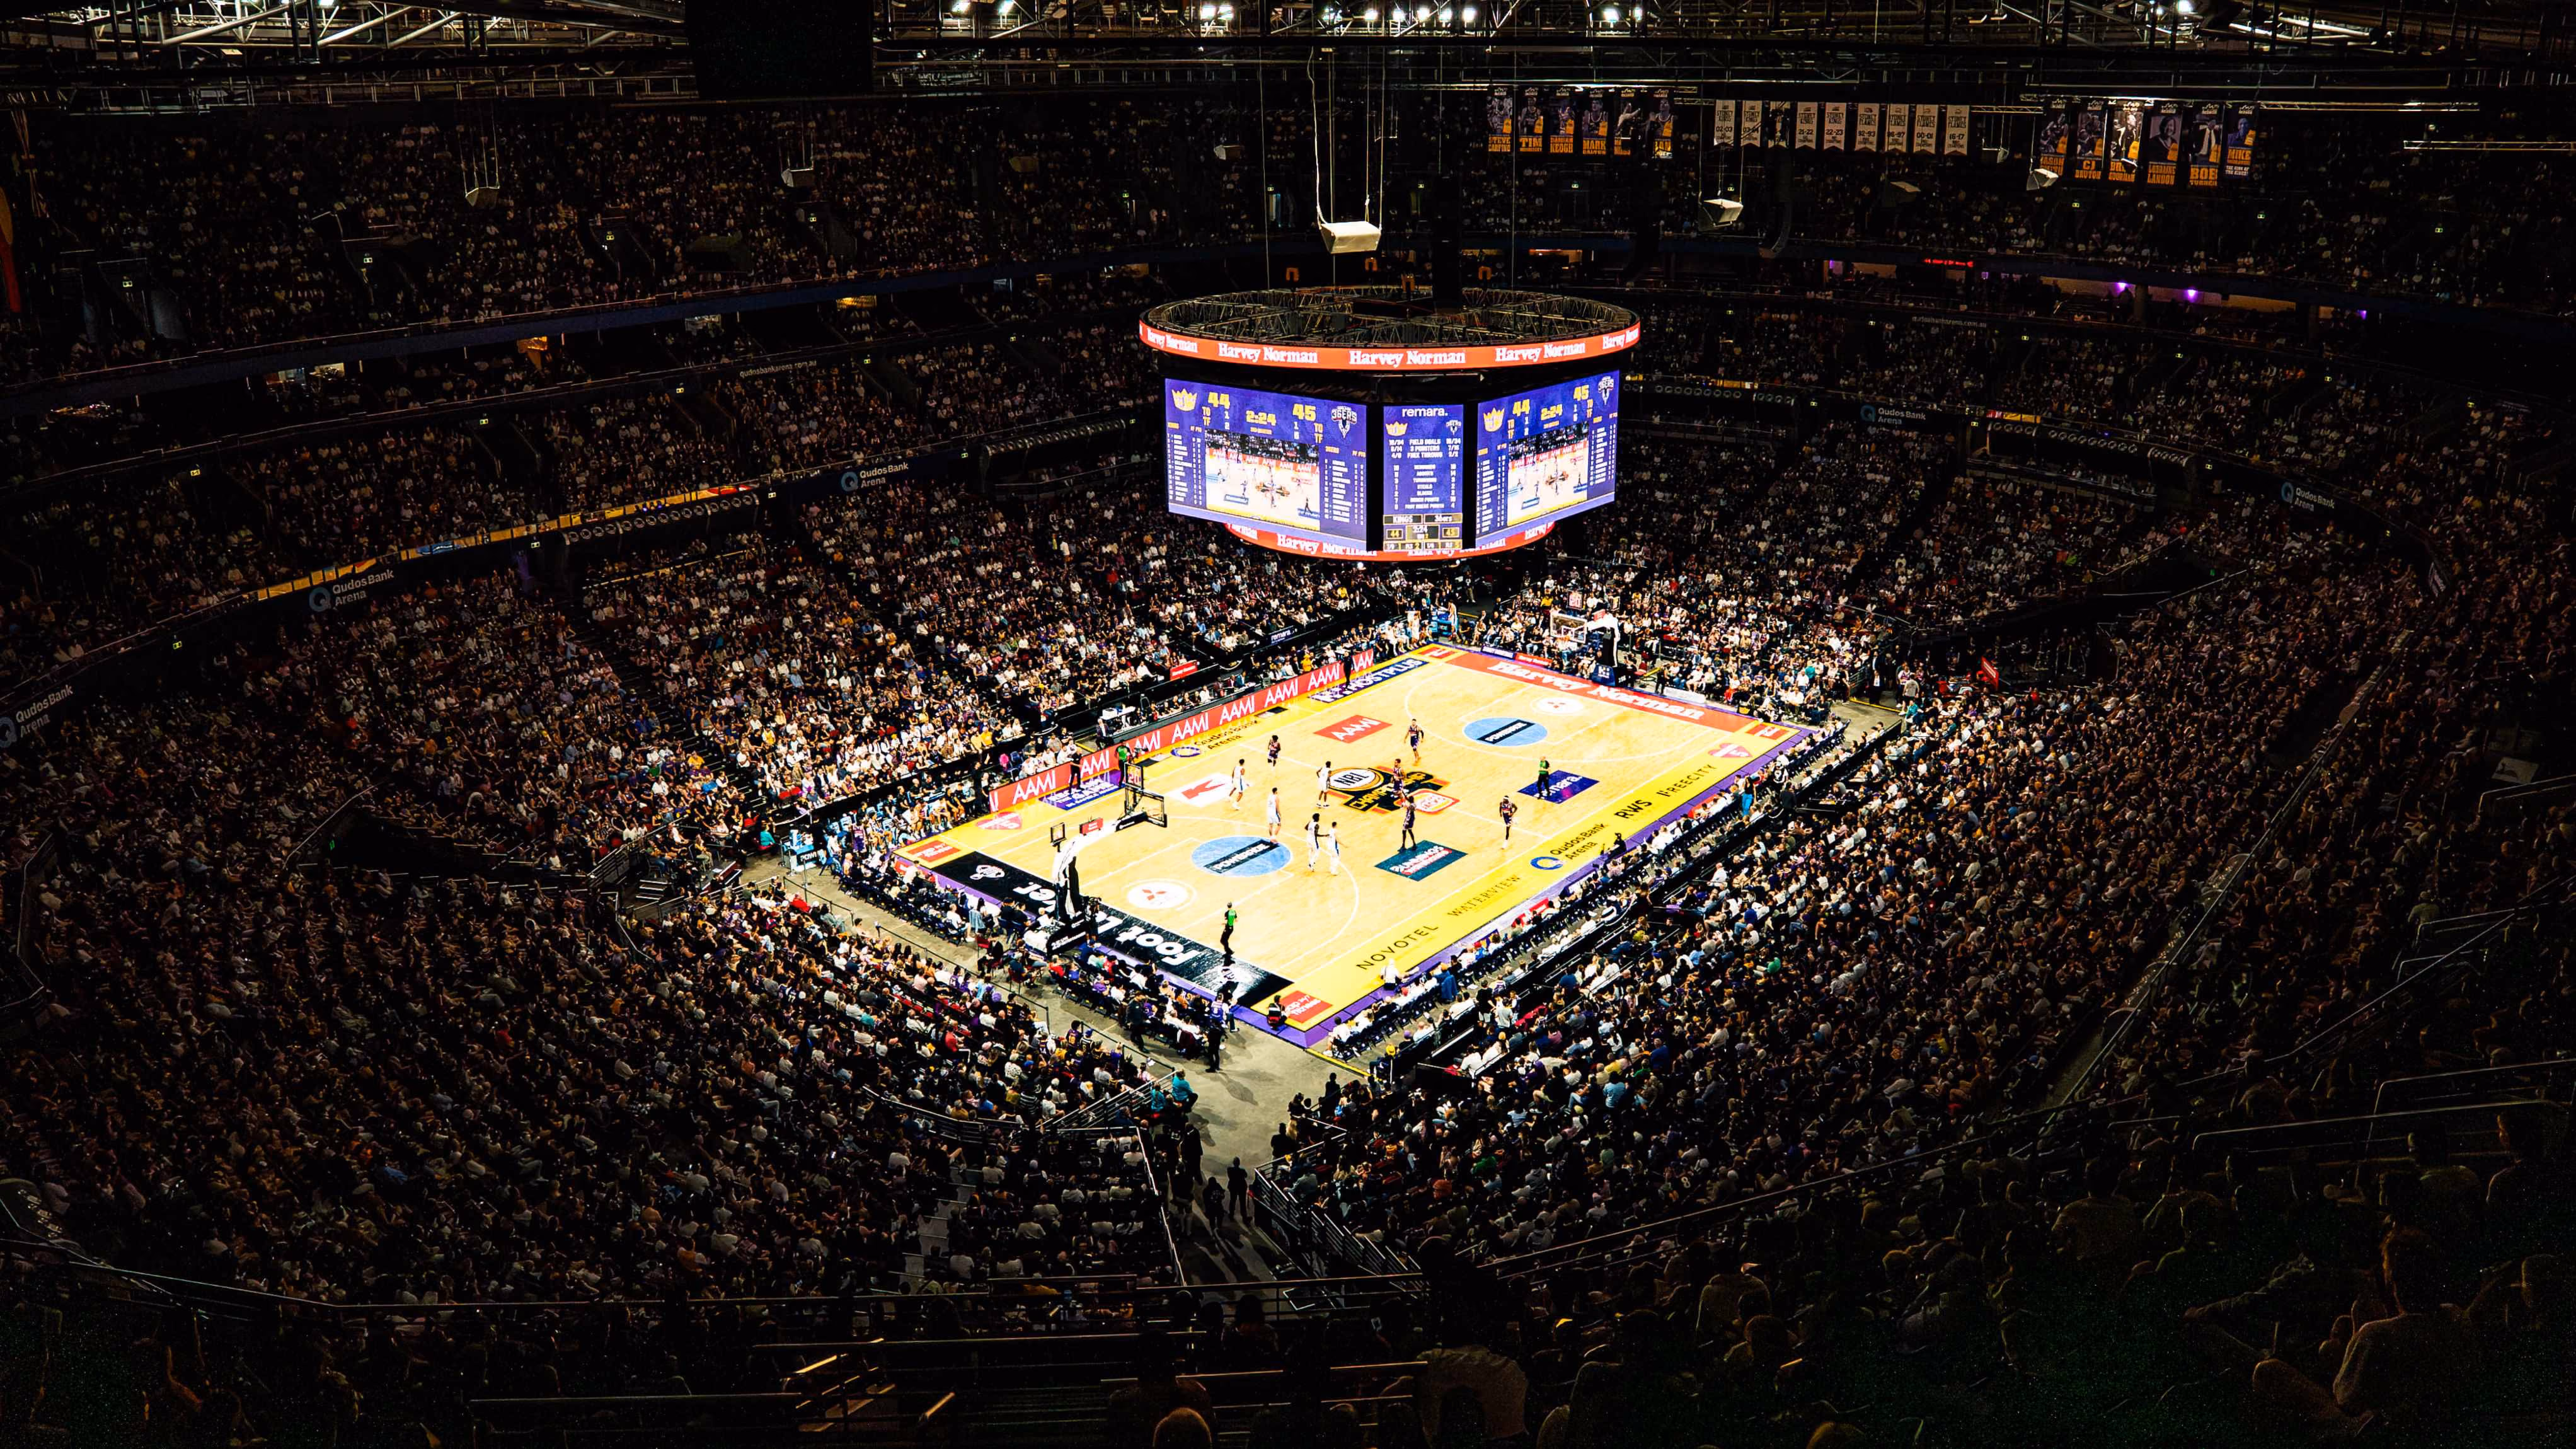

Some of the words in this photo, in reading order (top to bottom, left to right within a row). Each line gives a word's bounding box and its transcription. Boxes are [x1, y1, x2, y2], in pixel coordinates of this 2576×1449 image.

[1218, 342, 1260, 362] Harvey
[1263, 347, 1318, 364] Norman
[1349, 350, 1403, 368] Harvey
[1406, 350, 1466, 364] Norman
[1495, 346, 1542, 362] Harvey
[1544, 342, 1586, 359] Norman
[1208, 391, 1231, 409] 44
[1573, 385, 1589, 401] 45
[1246, 410, 1277, 426] 2:24
[1292, 403, 1316, 422] 45
[1331, 408, 1357, 424] 36ERS
[1402, 408, 1448, 417] remara.
[1513, 399, 1530, 417] 44
[1541, 404, 1563, 420] 2:24
[861, 477, 886, 488] Arena
[1277, 534, 1321, 555] Harvey
[335, 589, 367, 607] Arena
[1308, 665, 1340, 691] AAMI
[1264, 679, 1299, 708] AAMI
[1487, 661, 1592, 691] Harvey
[1587, 684, 1705, 720] Norman
[1219, 695, 1255, 725] AAMI
[1171, 713, 1209, 744] AAMI
[1331, 717, 1382, 741] AAMI
[1070, 750, 1110, 782] AMI
[1013, 770, 1056, 804] AAMI
[1333, 772, 1370, 787] NBL
[1657, 764, 1717, 797] FREECITY
[1614, 800, 1653, 819] RWS
[1565, 841, 1598, 860] Arena
[1447, 874, 1521, 917] WATERVIEW
[1115, 925, 1202, 966] Foot
[1356, 924, 1439, 971] NOVOTEL
